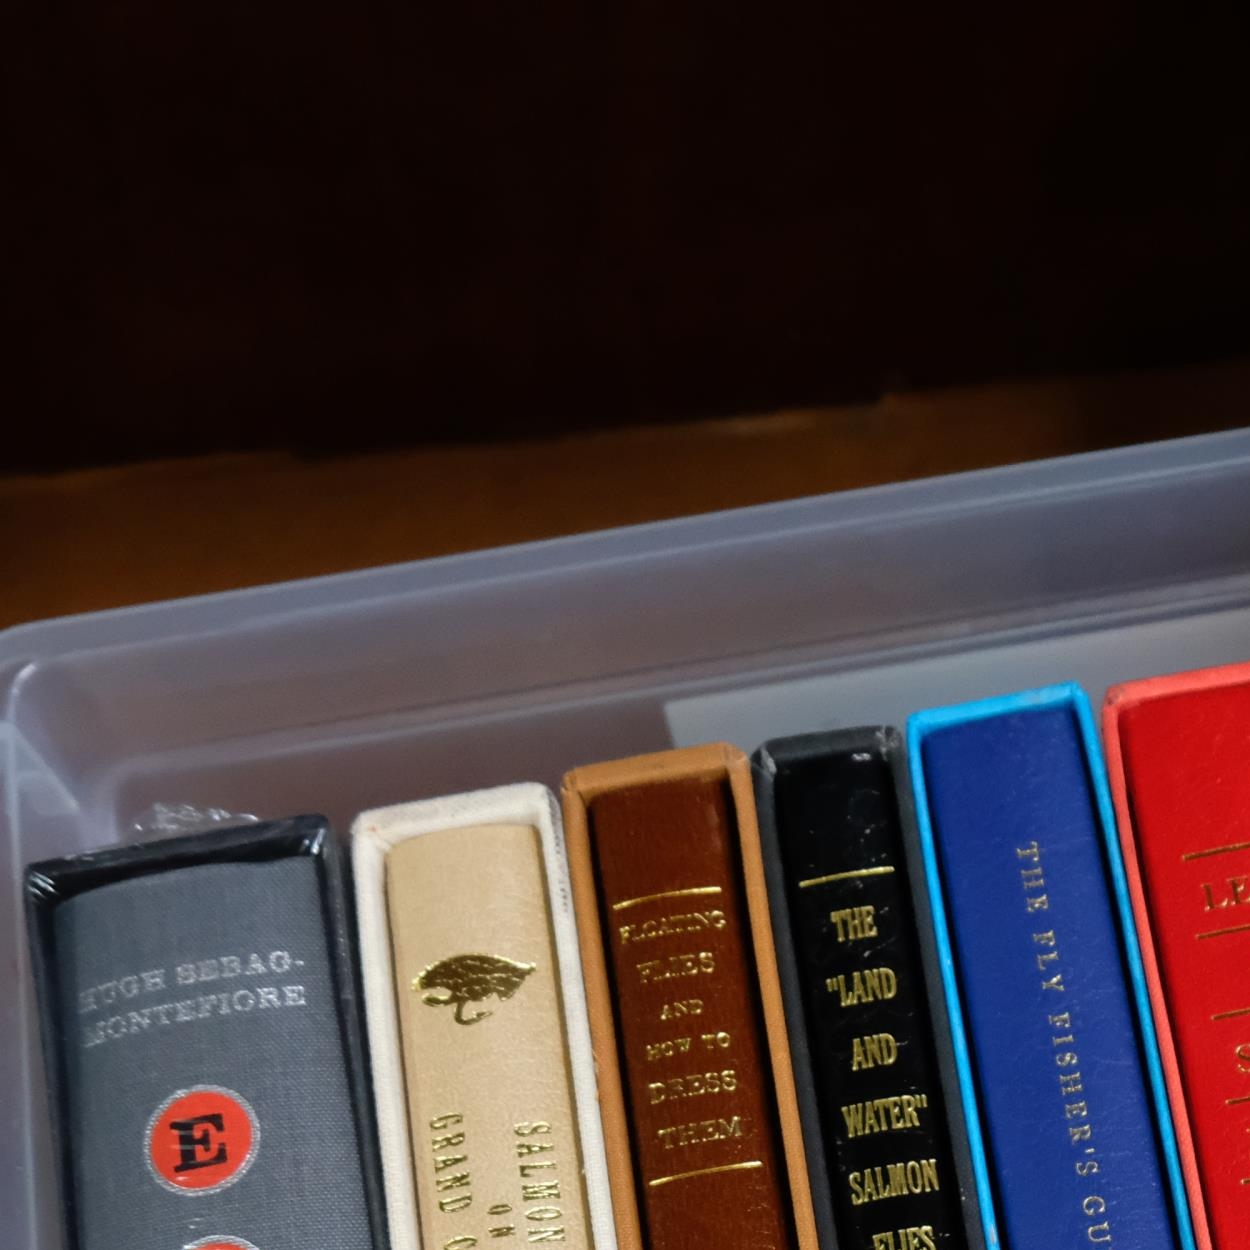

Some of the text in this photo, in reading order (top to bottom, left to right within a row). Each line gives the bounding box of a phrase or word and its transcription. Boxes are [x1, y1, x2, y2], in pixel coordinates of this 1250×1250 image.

[1016, 841, 1049, 912] THE
[619, 910, 727, 944] FLOATING
[830, 905, 878, 942] THE
[636, 952, 715, 983] FLIES
[1032, 929, 1064, 991] FLY
[78, 950, 305, 1014] HUGH SEBAG-
[826, 967, 898, 1008] "LAND
[82, 985, 306, 1048] MONTEFIORE
[660, 999, 703, 1020] AND
[646, 1031, 731, 1061] HOW TO
[852, 1033, 898, 1071] AND
[649, 1070, 738, 1104] DRESS
[1049, 1011, 1100, 1176] FISHER'S
[657, 1115, 743, 1149] THEM
[841, 1094, 928, 1138] WATER"
[430, 1112, 472, 1214] GRAND
[514, 1120, 565, 1243] SALMON
[848, 1158, 940, 1206] SALMON
[488, 1203, 516, 1238] ON
